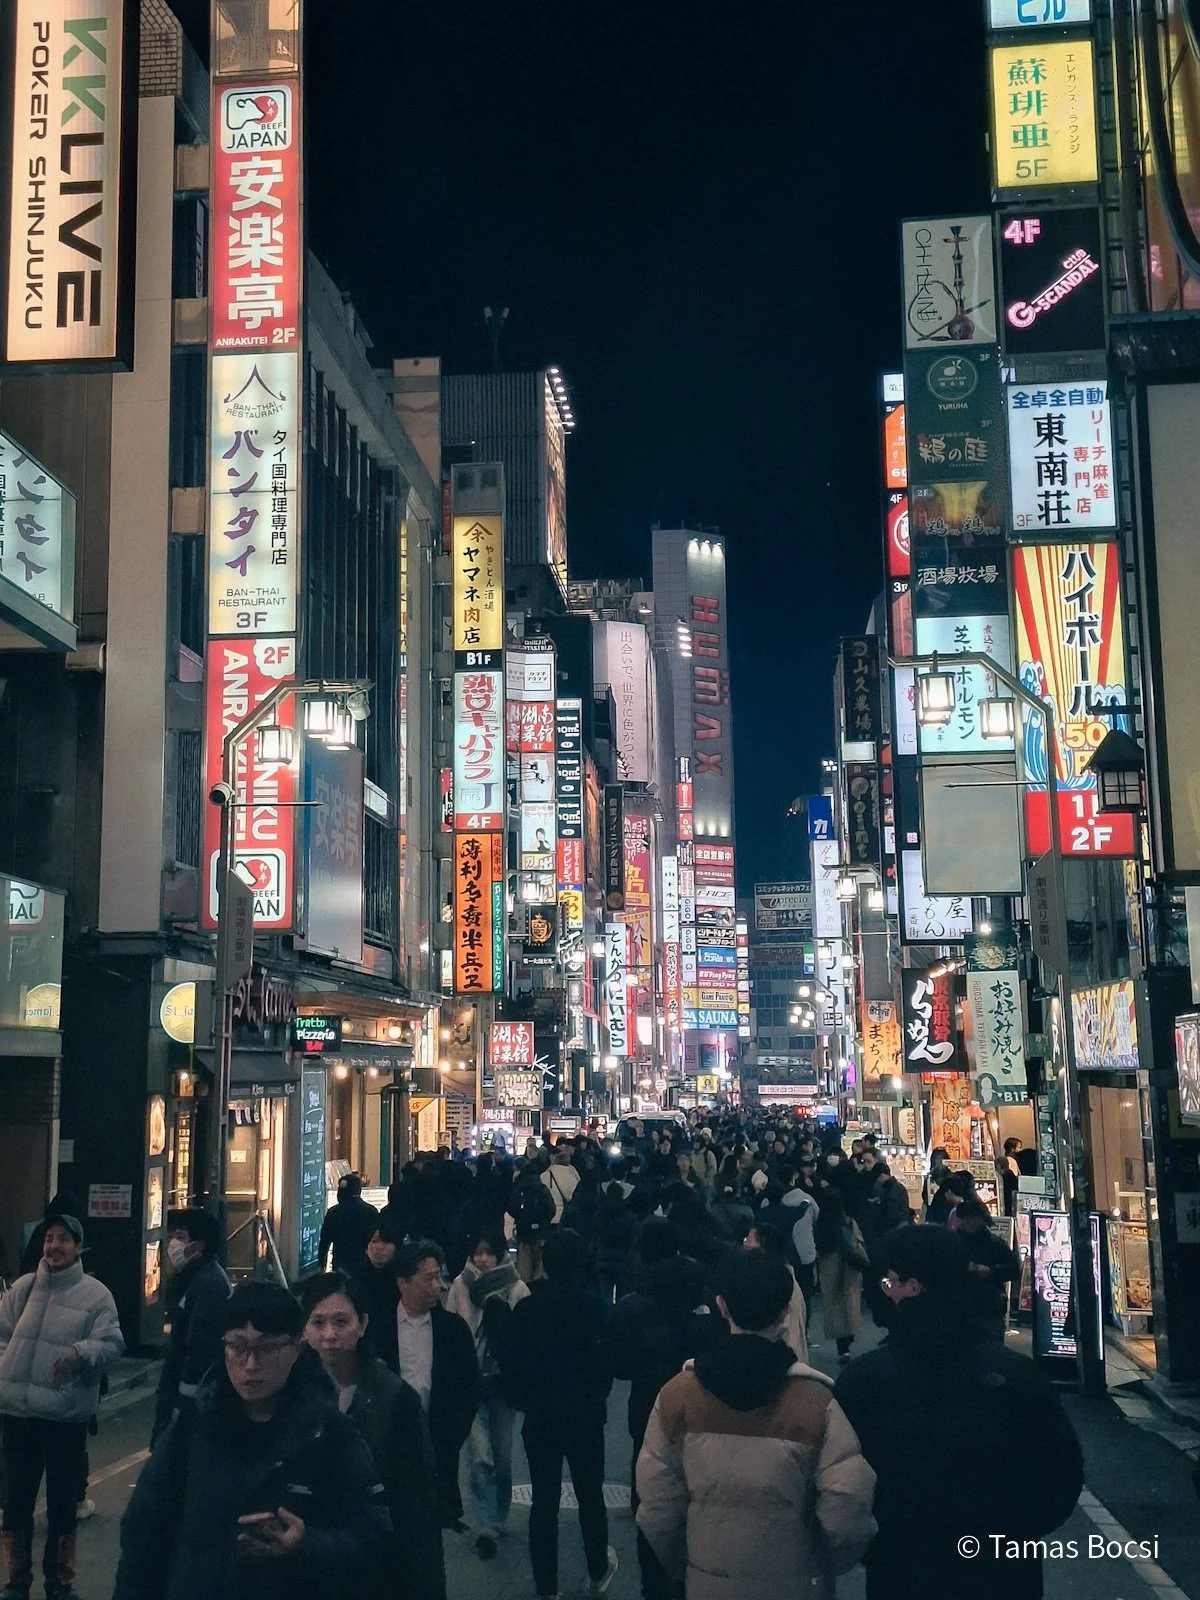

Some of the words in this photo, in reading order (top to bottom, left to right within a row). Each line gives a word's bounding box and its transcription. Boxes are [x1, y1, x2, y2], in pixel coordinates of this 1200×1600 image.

[30, 22, 50, 139] POKER
[1066, 54, 1080, 153] エレガンス・ラウンジ
[227, 131, 287, 149] JAPAN
[1016, 159, 1048, 178] 5F
[25, 156, 46, 328] SHINJUKU
[228, 156, 284, 329] 安楽亭
[1004, 219, 1041, 244] 4F
[1063, 248, 1087, 270] CLUB
[216, 336, 268, 346] ANRAKUTEI
[272, 328, 295, 344] 2F
[1012, 387, 1104, 409] 全卓全自動
[226, 405, 286, 419] RESTAURANT
[1091, 410, 1110, 499] リーチ麻雀
[1032, 412, 1071, 526] 東南荘
[1073, 446, 1091, 514] 専門店
[222, 430, 264, 577] バンタイ
[271, 430, 288, 565] タイ国料理専門店
[890, 493, 902, 504] 4F
[1016, 514, 1032, 527] 3F
[484, 545, 494, 612] やきとん酒場
[918, 565, 999, 586] 酒場牧場
[218, 597, 286, 607] RESTAURANT
[226, 588, 280, 597] BAN-THAI
[462, 547, 480, 644] ヤマネ肉店
[236, 612, 267, 628] 3F
[1059, 550, 1102, 718] ハイボール
[264, 647, 289, 664] 2F
[467, 652, 491, 665] B1F
[1064, 722, 1107, 749] 50
[473, 783, 499, 810] J
[467, 815, 491, 828] 4F
[1071, 827, 1113, 850] 2F
[974, 980, 983, 1018] HIROSHIMA
[698, 1010, 738, 1023] SAUNA
[990, 980, 1021, 1074] お好み焼き
[296, 1028, 336, 1041] Pizzeria
[1005, 1092, 1028, 1102] B1F
